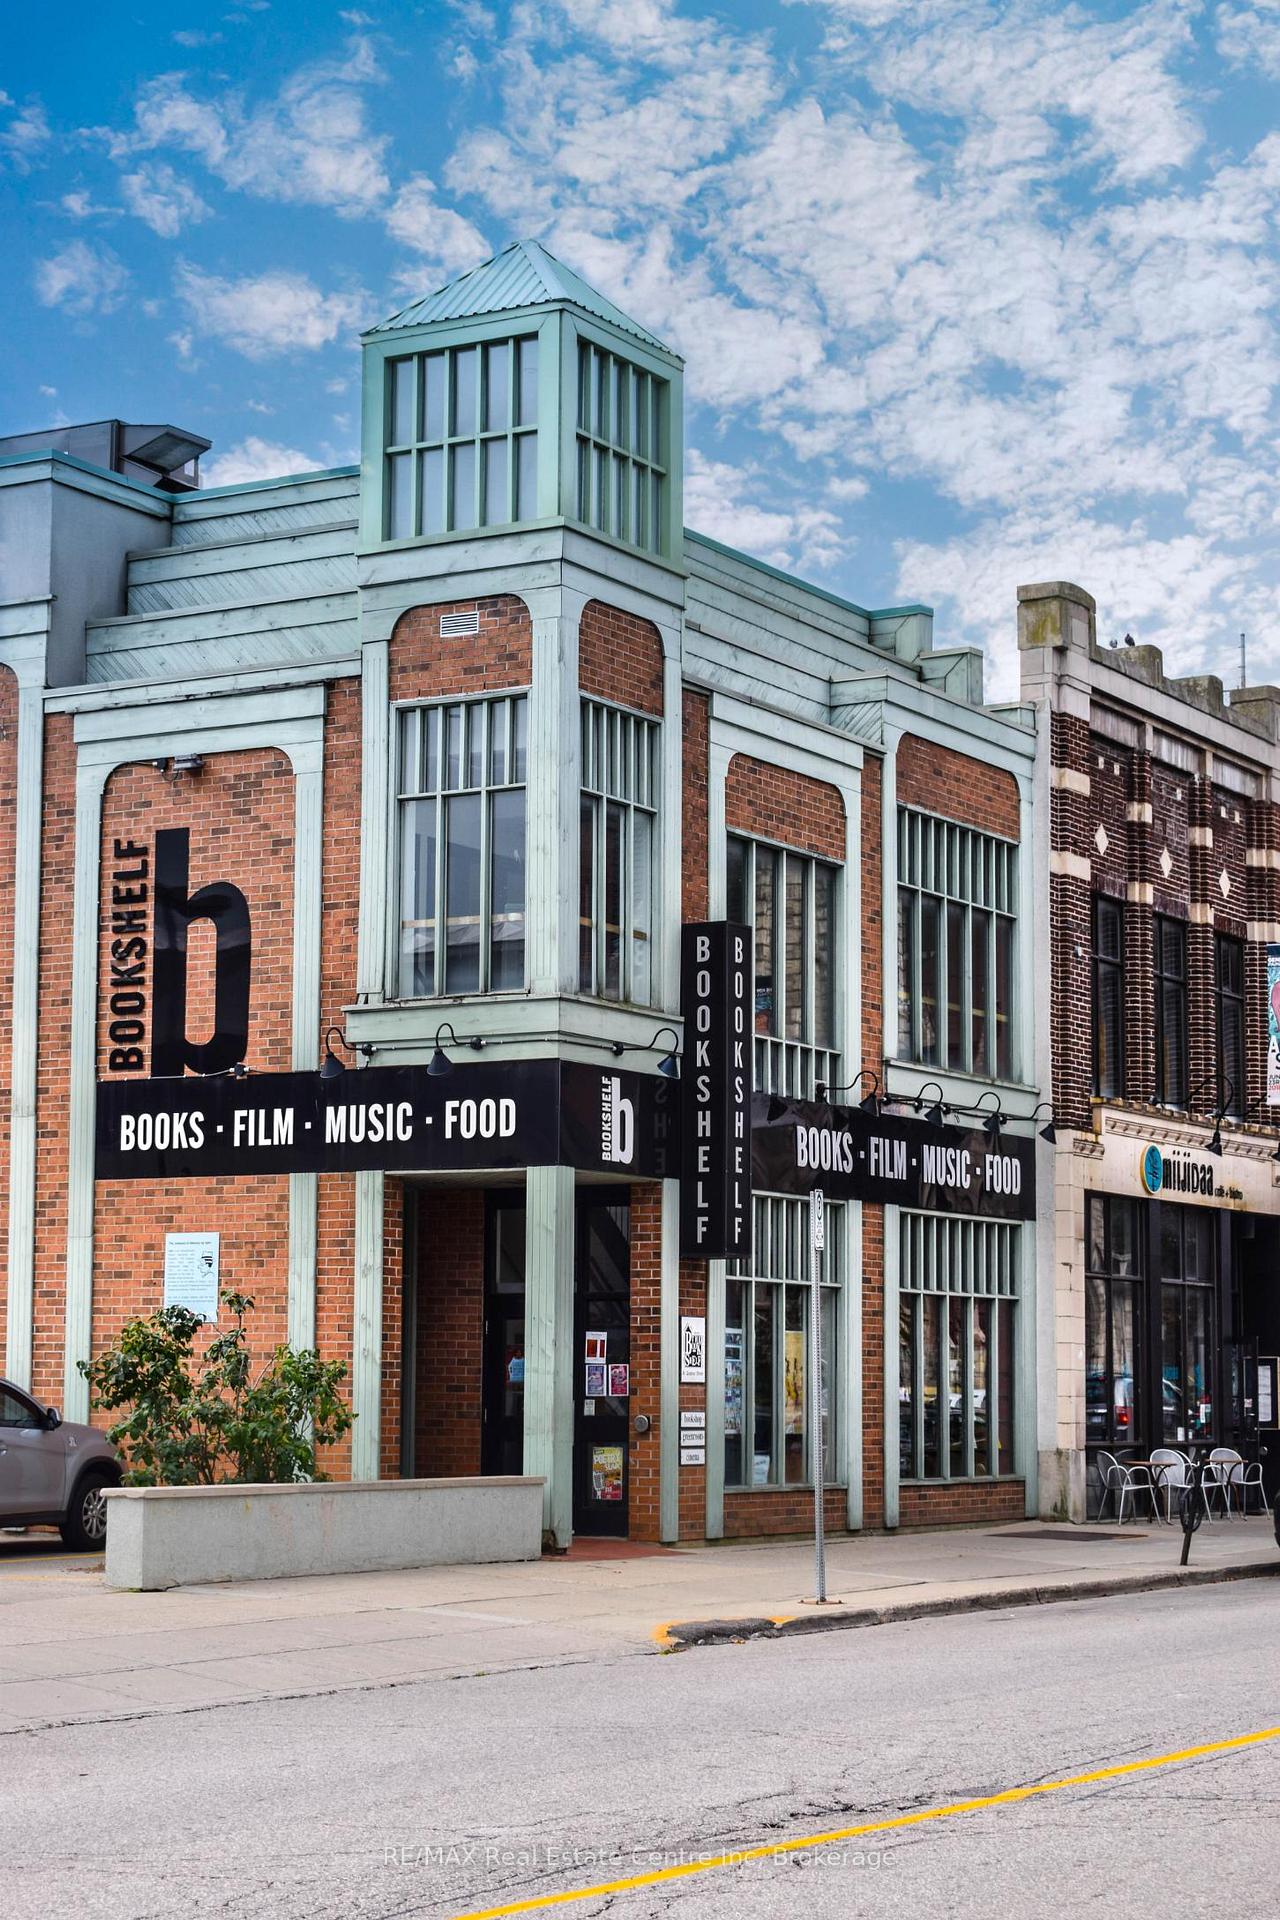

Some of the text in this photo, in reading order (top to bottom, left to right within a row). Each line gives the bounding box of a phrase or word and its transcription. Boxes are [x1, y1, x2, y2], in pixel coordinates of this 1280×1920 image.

[109, 838, 149, 1071] BOOKSHELF
[120, 1098, 516, 1151] BOOKS FILM MUSIC FOOD
[602, 1076, 611, 1160] BOOKSHELF
[696, 936, 711, 1244] BOOKSHELF
[734, 936, 744, 1244] BOOKSHELF
[796, 1125, 1021, 1195] BOOKS FILM MUSIC FOOD
